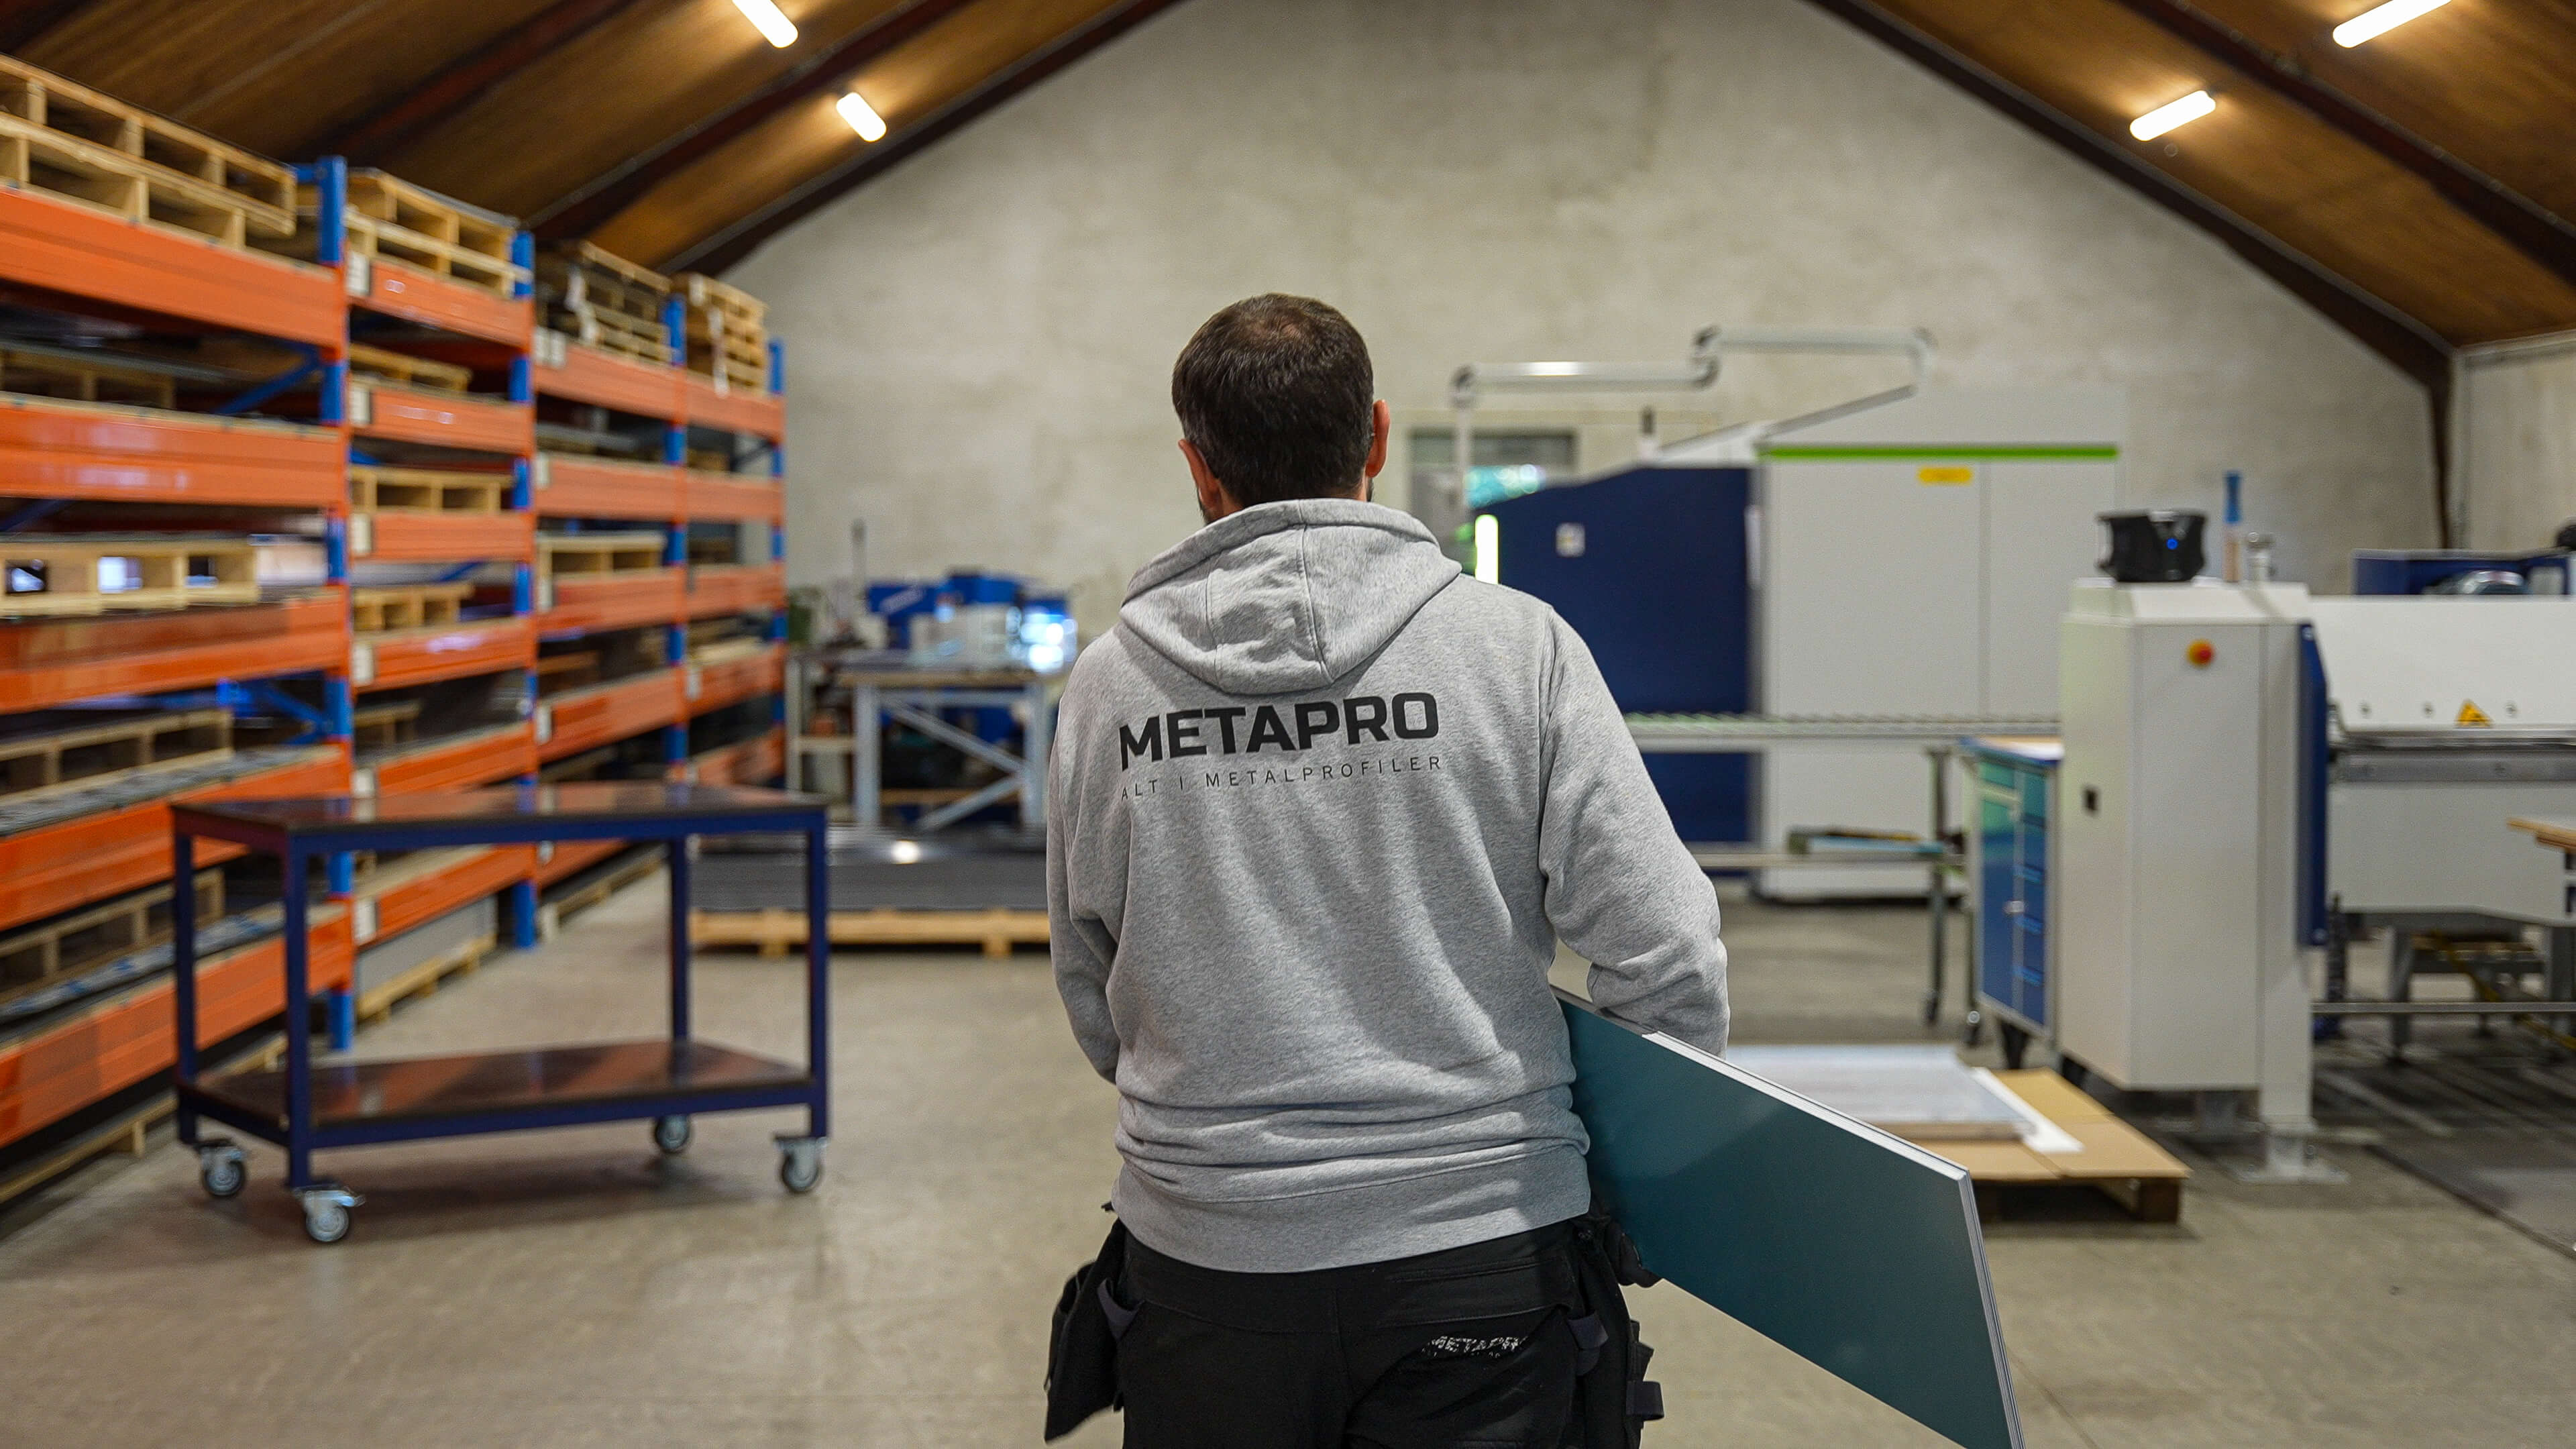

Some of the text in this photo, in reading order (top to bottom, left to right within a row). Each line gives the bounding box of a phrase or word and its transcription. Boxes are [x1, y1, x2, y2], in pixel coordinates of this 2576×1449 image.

[1118, 692, 1439, 772] METAPRO
[1120, 779, 1159, 801] ALT
[1205, 755, 1442, 789] METALPROFILER
